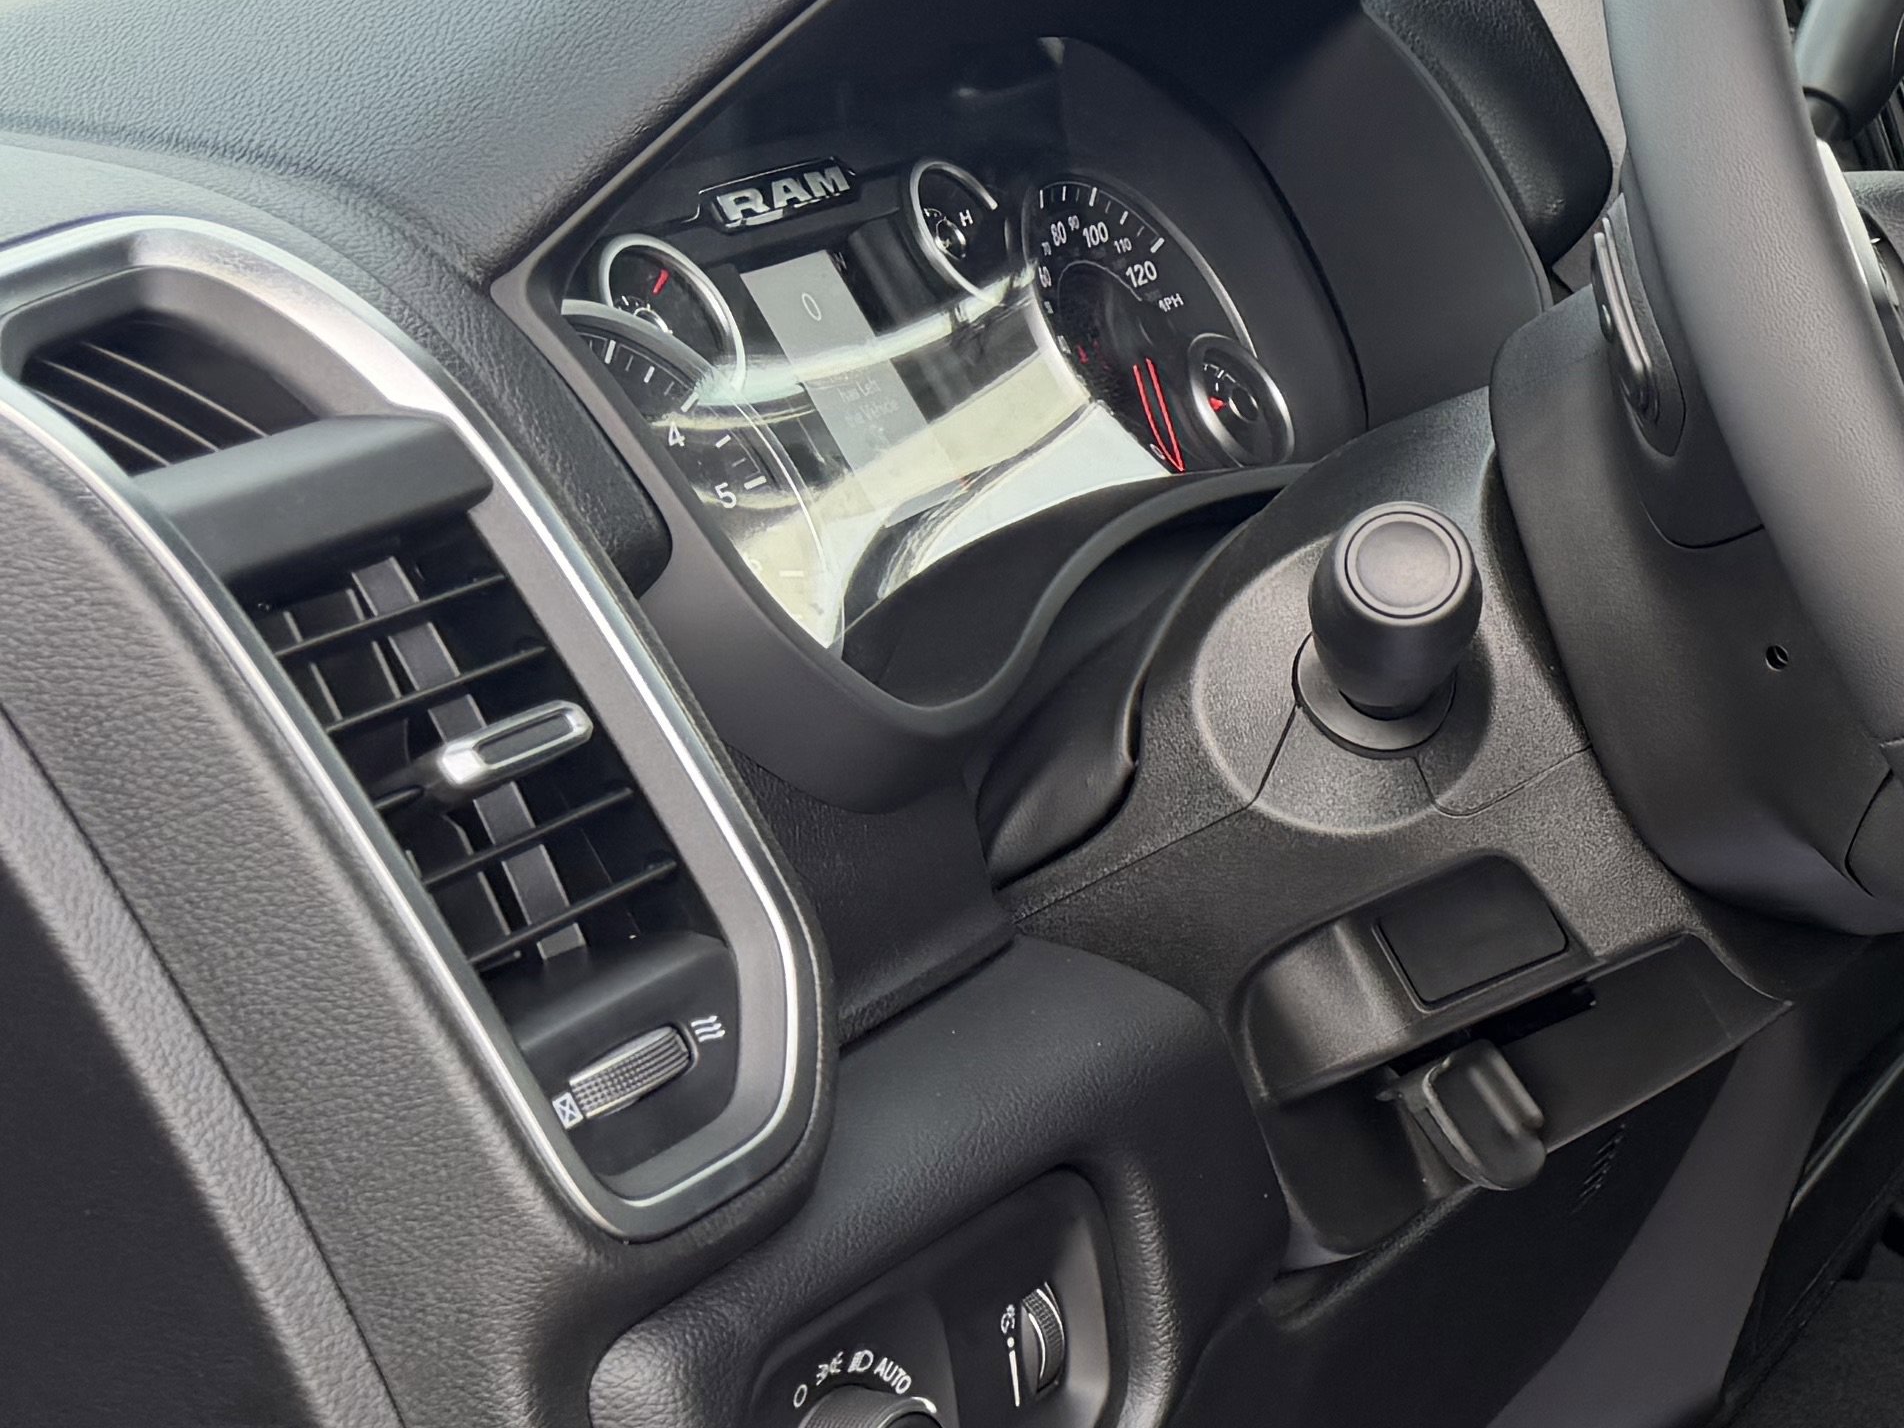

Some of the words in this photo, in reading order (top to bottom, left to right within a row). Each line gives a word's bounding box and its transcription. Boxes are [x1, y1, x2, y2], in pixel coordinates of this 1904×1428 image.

[716, 166, 850, 224] RAM
[959, 209, 974, 227] H
[1050, 221, 1067, 247] 80
[1082, 222, 1109, 248] 100
[1114, 237, 1132, 254] 110
[1125, 260, 1158, 288] 120
[801, 292, 822, 321] 0
[667, 422, 685, 447] 4
[714, 482, 737, 509] 5
[873, 1357, 912, 1394] AUTO
